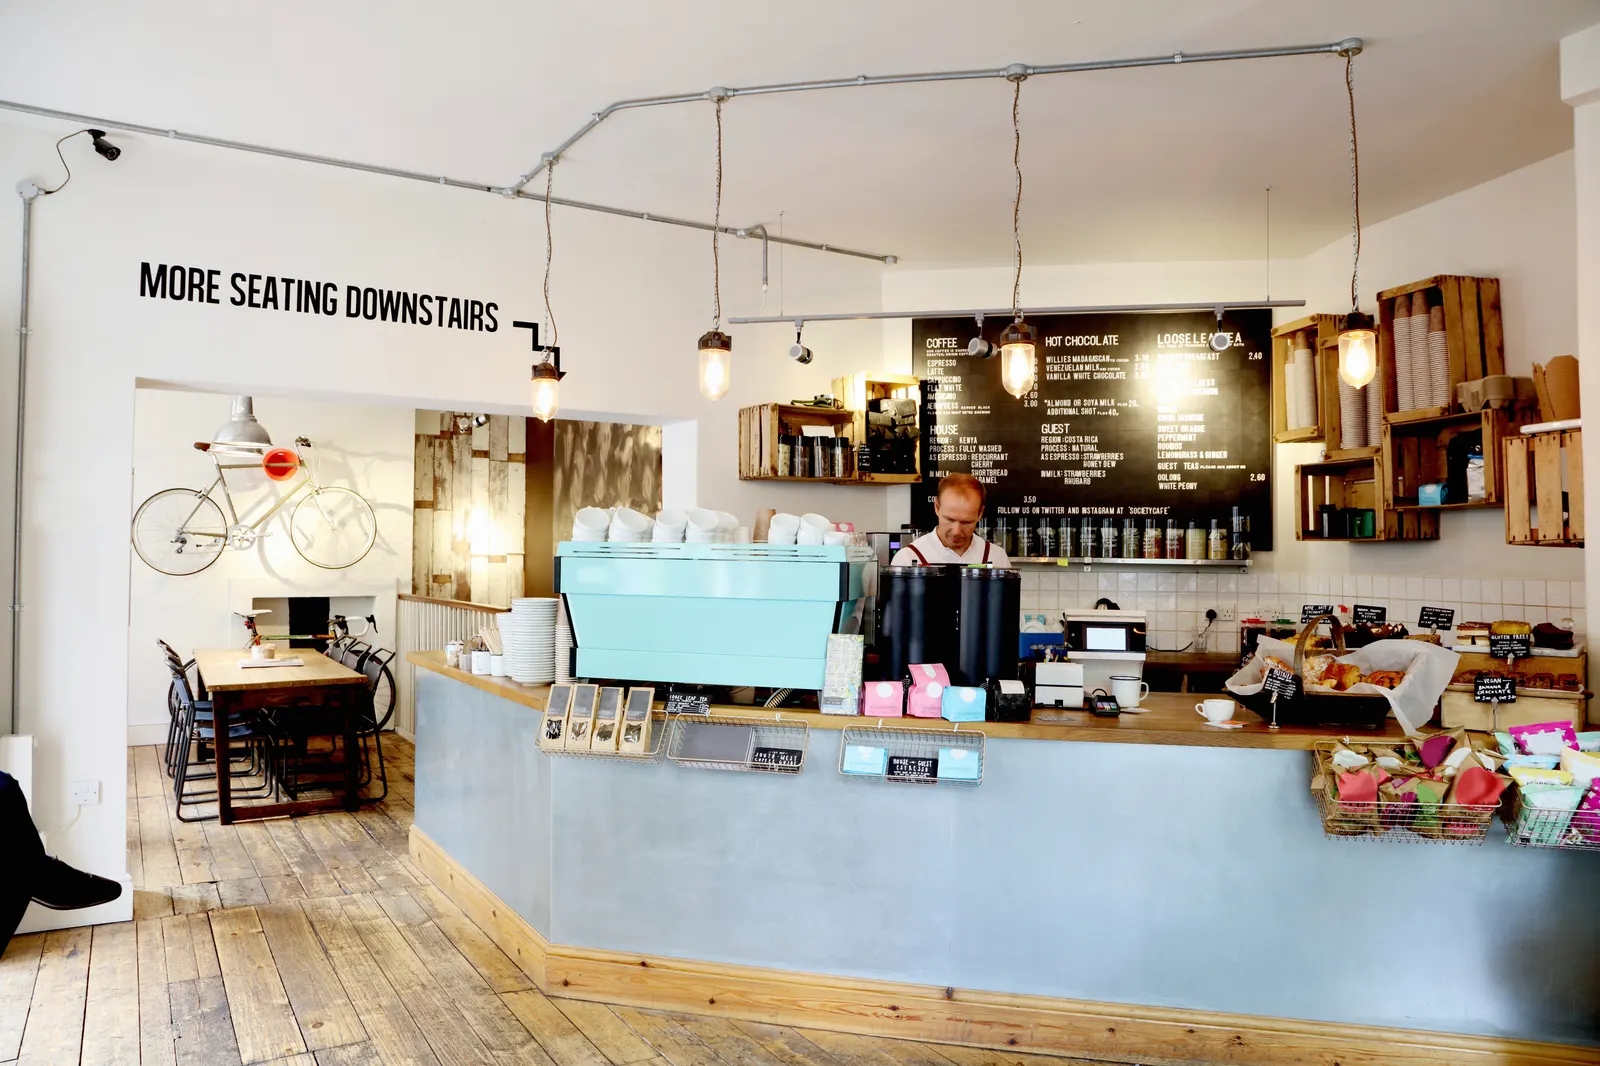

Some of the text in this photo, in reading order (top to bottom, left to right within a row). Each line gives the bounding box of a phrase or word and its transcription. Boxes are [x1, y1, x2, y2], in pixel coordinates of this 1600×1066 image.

[139, 262, 499, 332] MORE SEATING DOWNSTAIRS
[926, 338, 958, 348] COFFEE
[1046, 335, 1119, 346] HOT CHOCOLATE
[1157, 333, 1191, 344] LOOSE
[1194, 333, 1214, 343] LEA
[930, 425, 958, 434] HOUSE
[1041, 423, 1070, 434] GUEST
